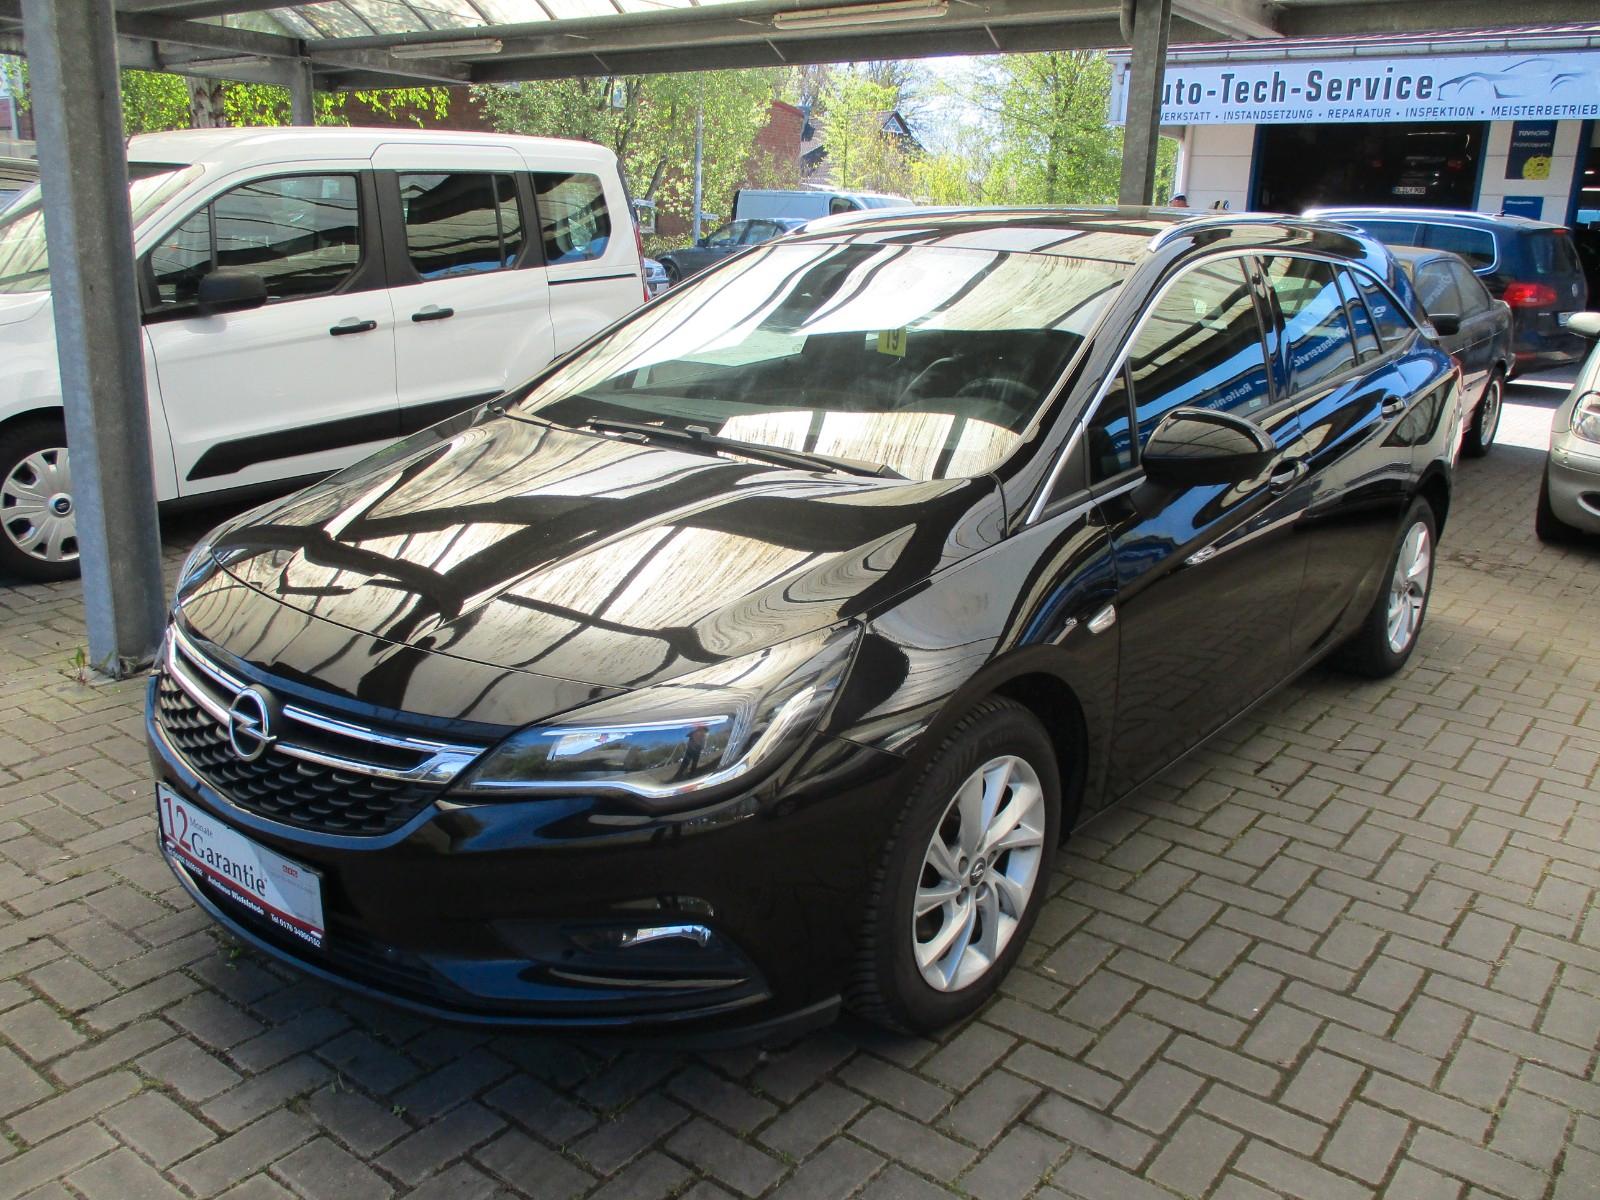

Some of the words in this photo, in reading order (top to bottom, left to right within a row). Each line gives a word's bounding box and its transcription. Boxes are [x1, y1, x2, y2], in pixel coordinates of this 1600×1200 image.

[1161, 67, 1433, 105] uto-Tech-Service
[1223, 110, 1313, 120] INSTANDSETZUNG
[1327, 108, 1391, 119] REPARATUR
[1405, 106, 1475, 117] INSPEKTION
[1491, 104, 1598, 116] MEISTERBETRIEB
[163, 797, 192, 852] 12
[191, 832, 266, 897] Garantie
